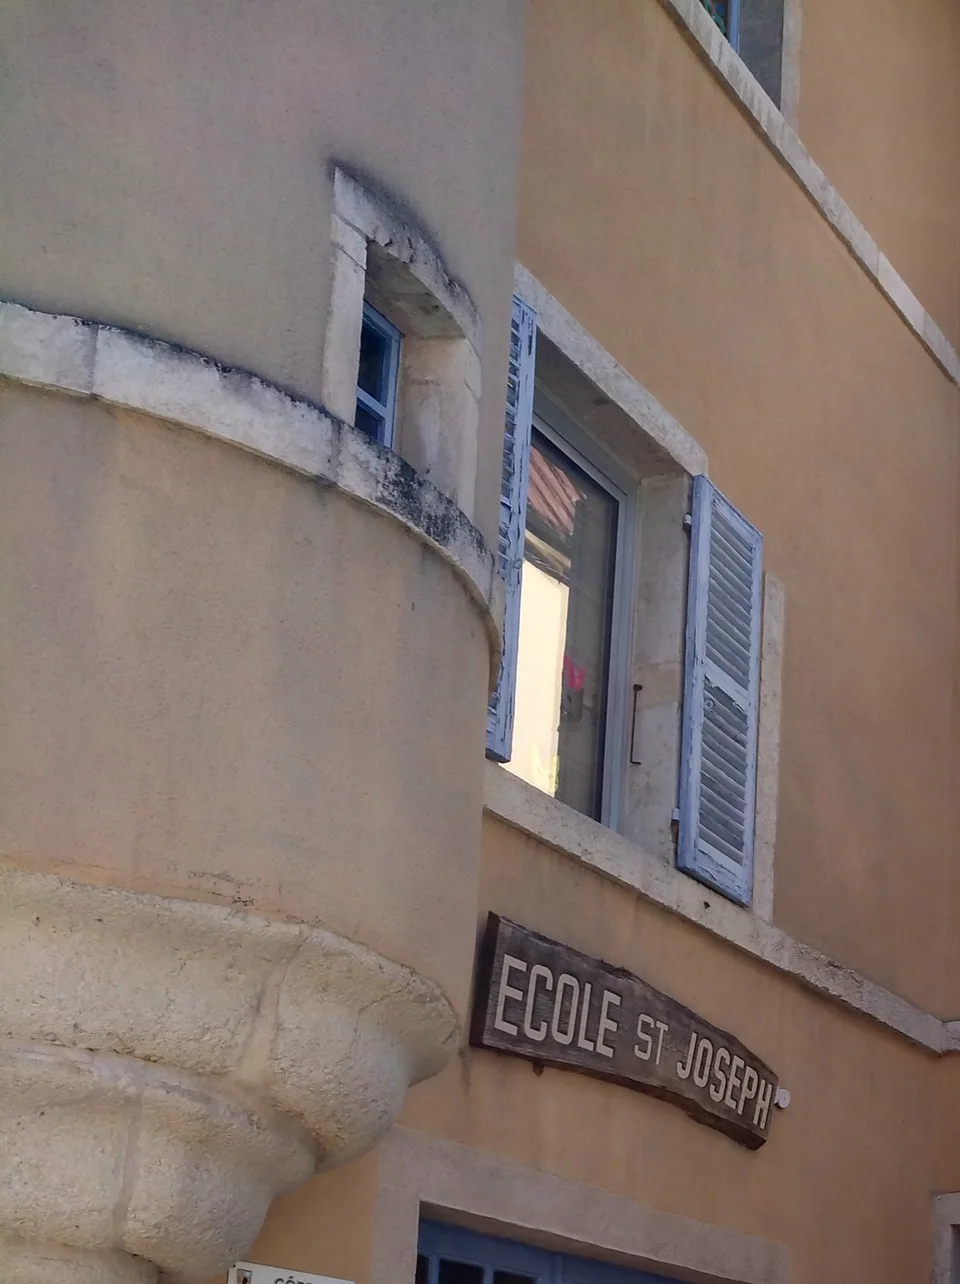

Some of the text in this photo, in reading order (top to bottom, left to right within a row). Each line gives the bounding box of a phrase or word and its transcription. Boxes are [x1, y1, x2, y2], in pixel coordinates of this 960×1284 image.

[494, 953, 773, 1130] ECOLE ST JOSEPH
